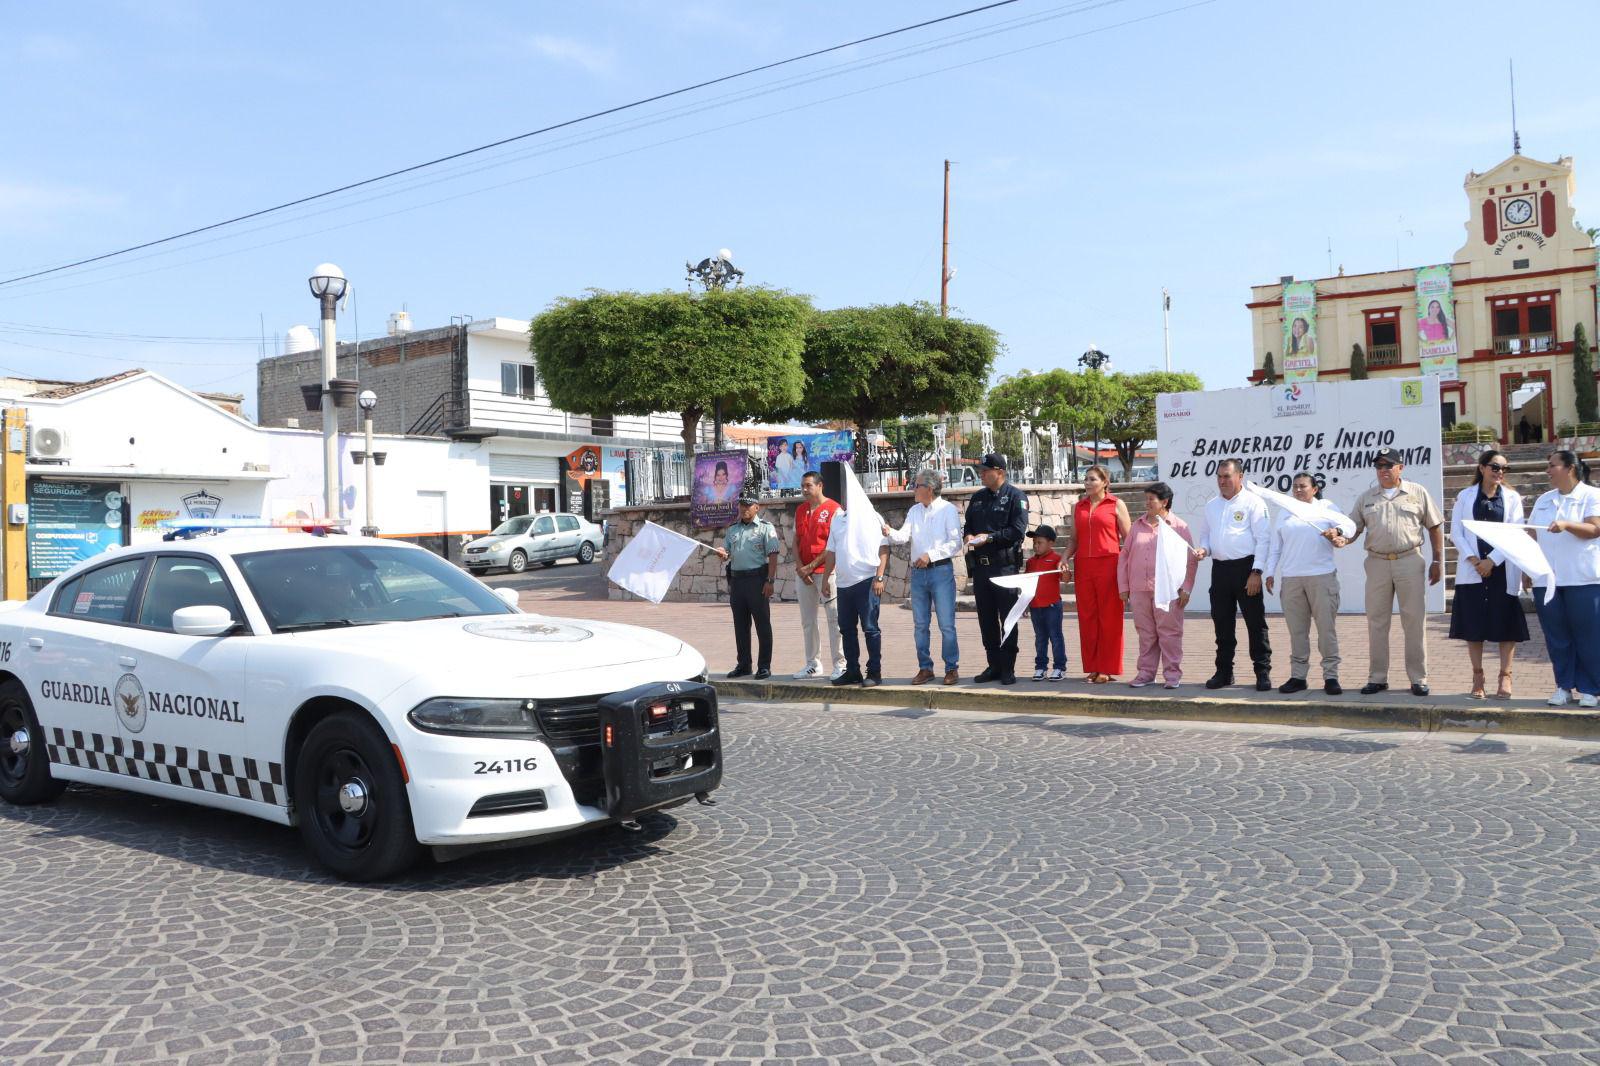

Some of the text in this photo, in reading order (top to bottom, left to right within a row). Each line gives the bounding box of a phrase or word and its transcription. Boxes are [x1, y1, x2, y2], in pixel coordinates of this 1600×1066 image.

[1494, 230, 1546, 256] PALACIO MUNICIPAL
[1192, 427, 1395, 457] BANDERAZO DE INICIO
[1170, 461, 1197, 478] DEL
[1205, 456, 1286, 477] OATIVO
[1294, 453, 1312, 471] DE
[1317, 449, 1381, 471] SEMAN
[1264, 472, 1327, 493] 206
[666, 682, 681, 692] GN
[41, 680, 112, 706] GUARDIA
[149, 691, 245, 723] NACIONAL
[473, 757, 537, 775] 24116
